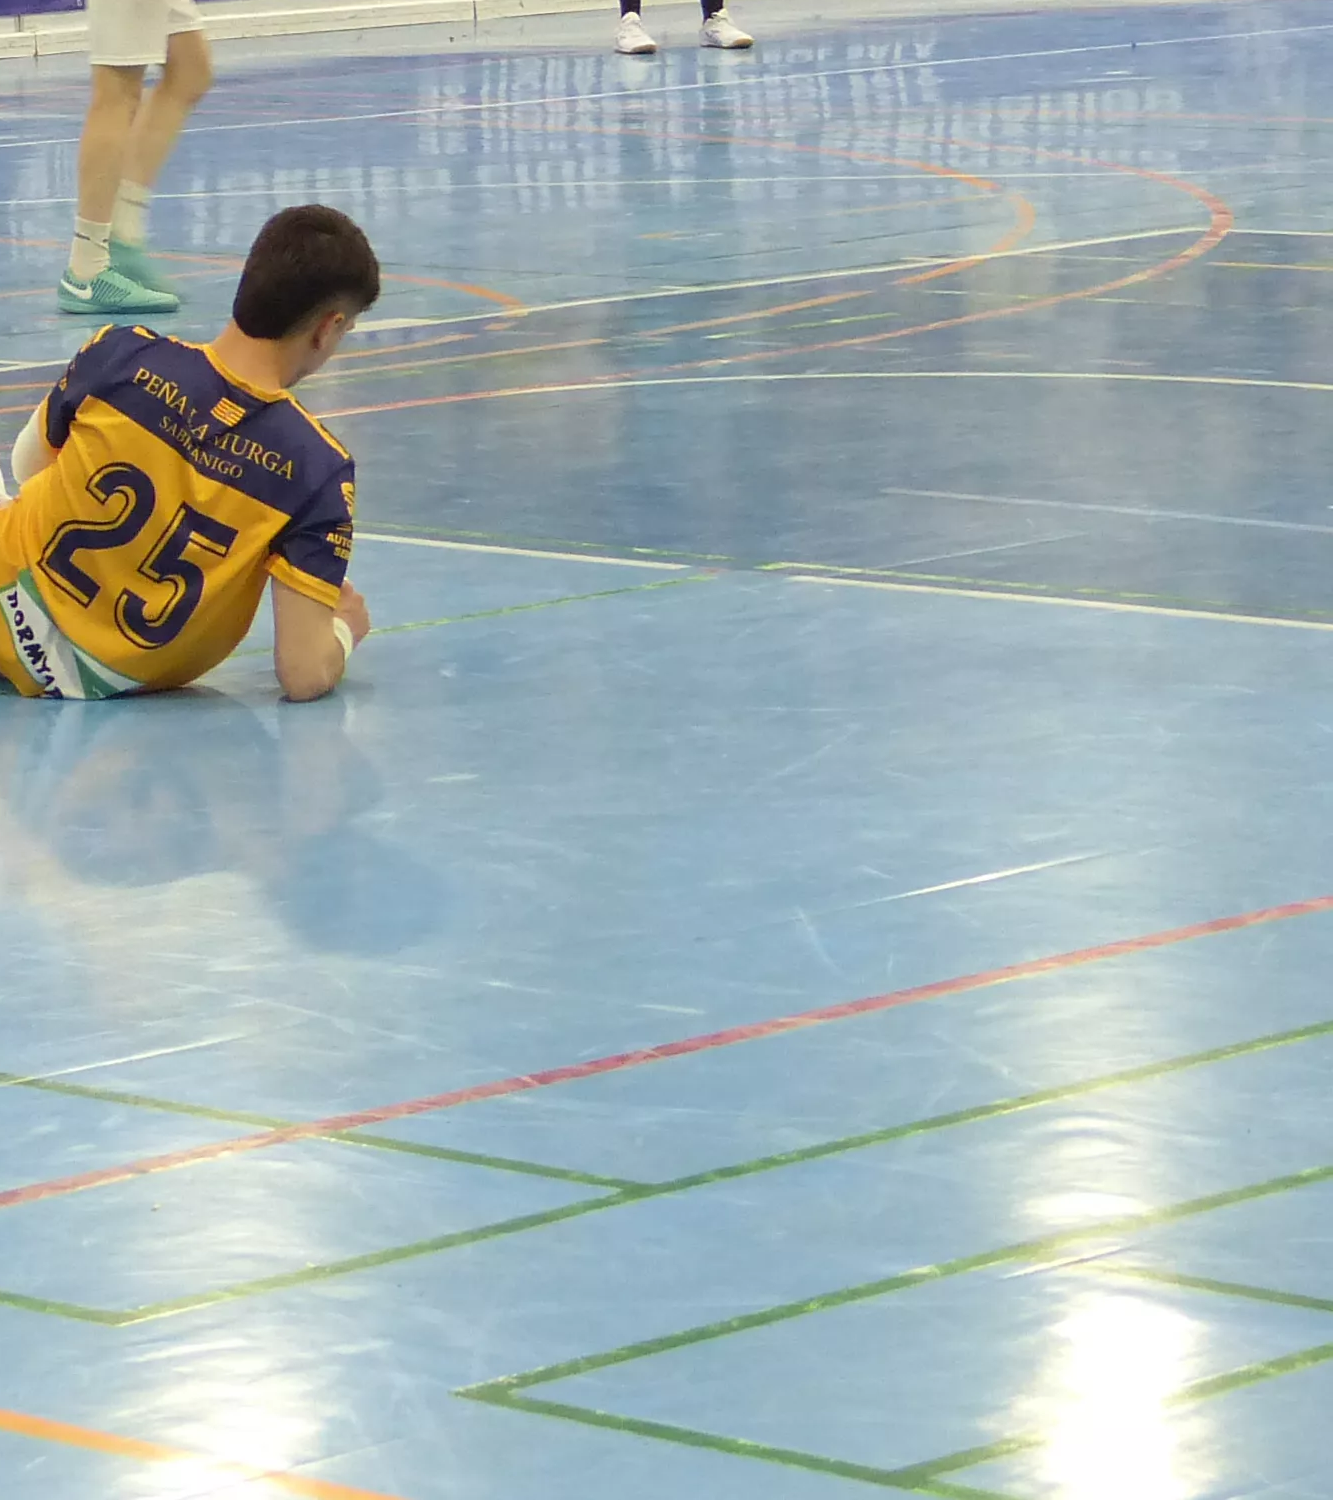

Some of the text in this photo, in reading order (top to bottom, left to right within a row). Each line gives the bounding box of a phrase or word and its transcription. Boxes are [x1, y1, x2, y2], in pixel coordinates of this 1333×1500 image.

[133, 367, 188, 415] PEÑA
[214, 432, 295, 481] MURGA
[37, 461, 239, 650] 25
